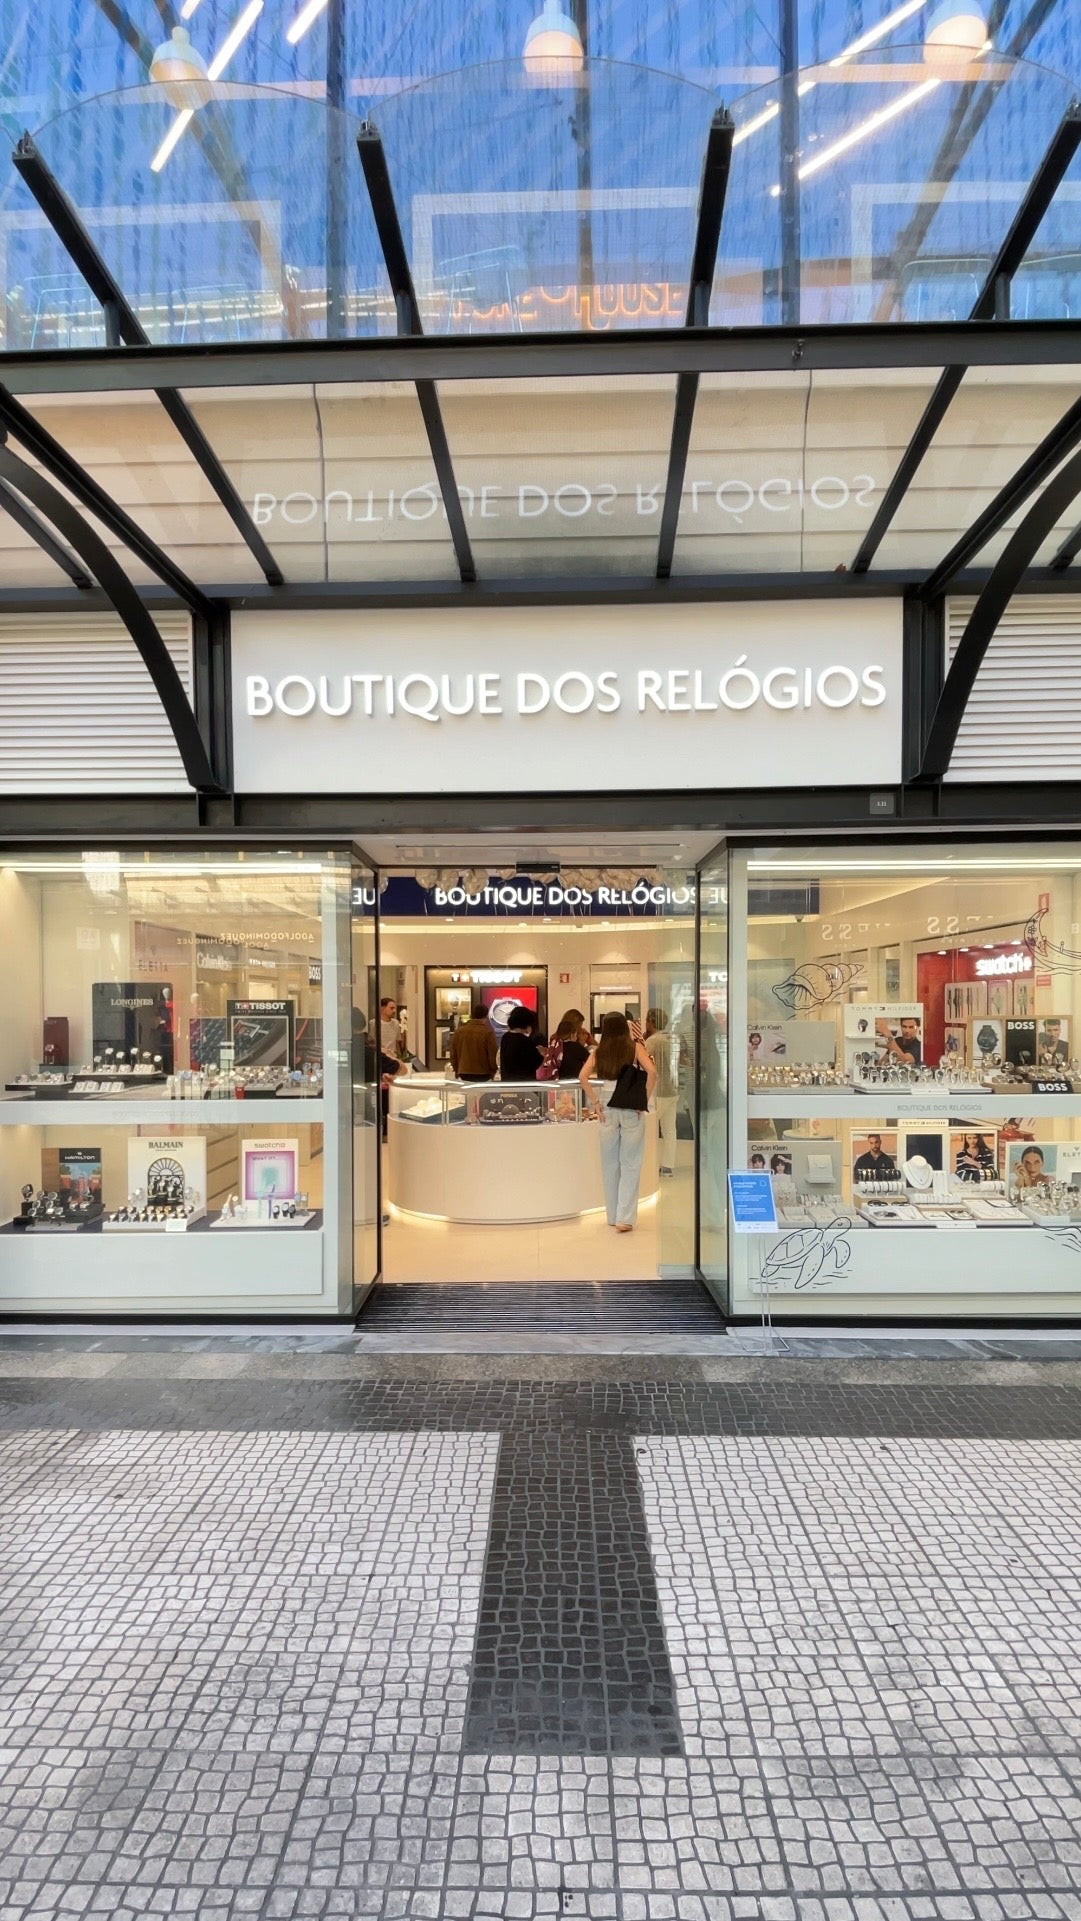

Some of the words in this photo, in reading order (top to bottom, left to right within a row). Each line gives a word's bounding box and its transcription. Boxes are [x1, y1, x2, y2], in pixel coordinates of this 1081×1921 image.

[245, 672, 503, 722] BOUTIQUE
[516, 670, 622, 716] DOS
[637, 653, 887, 713] RELÓGIOS
[435, 886, 544, 908] BOUTIQUE
[548, 886, 593, 906] DOS
[111, 998, 154, 1008] LONGINES
[249, 1002, 287, 1010] TISSOT
[1007, 1021, 1035, 1030] BOSS
[1037, 1082, 1068, 1092] BOSS
[148, 1141, 184, 1149] BALMAIN
